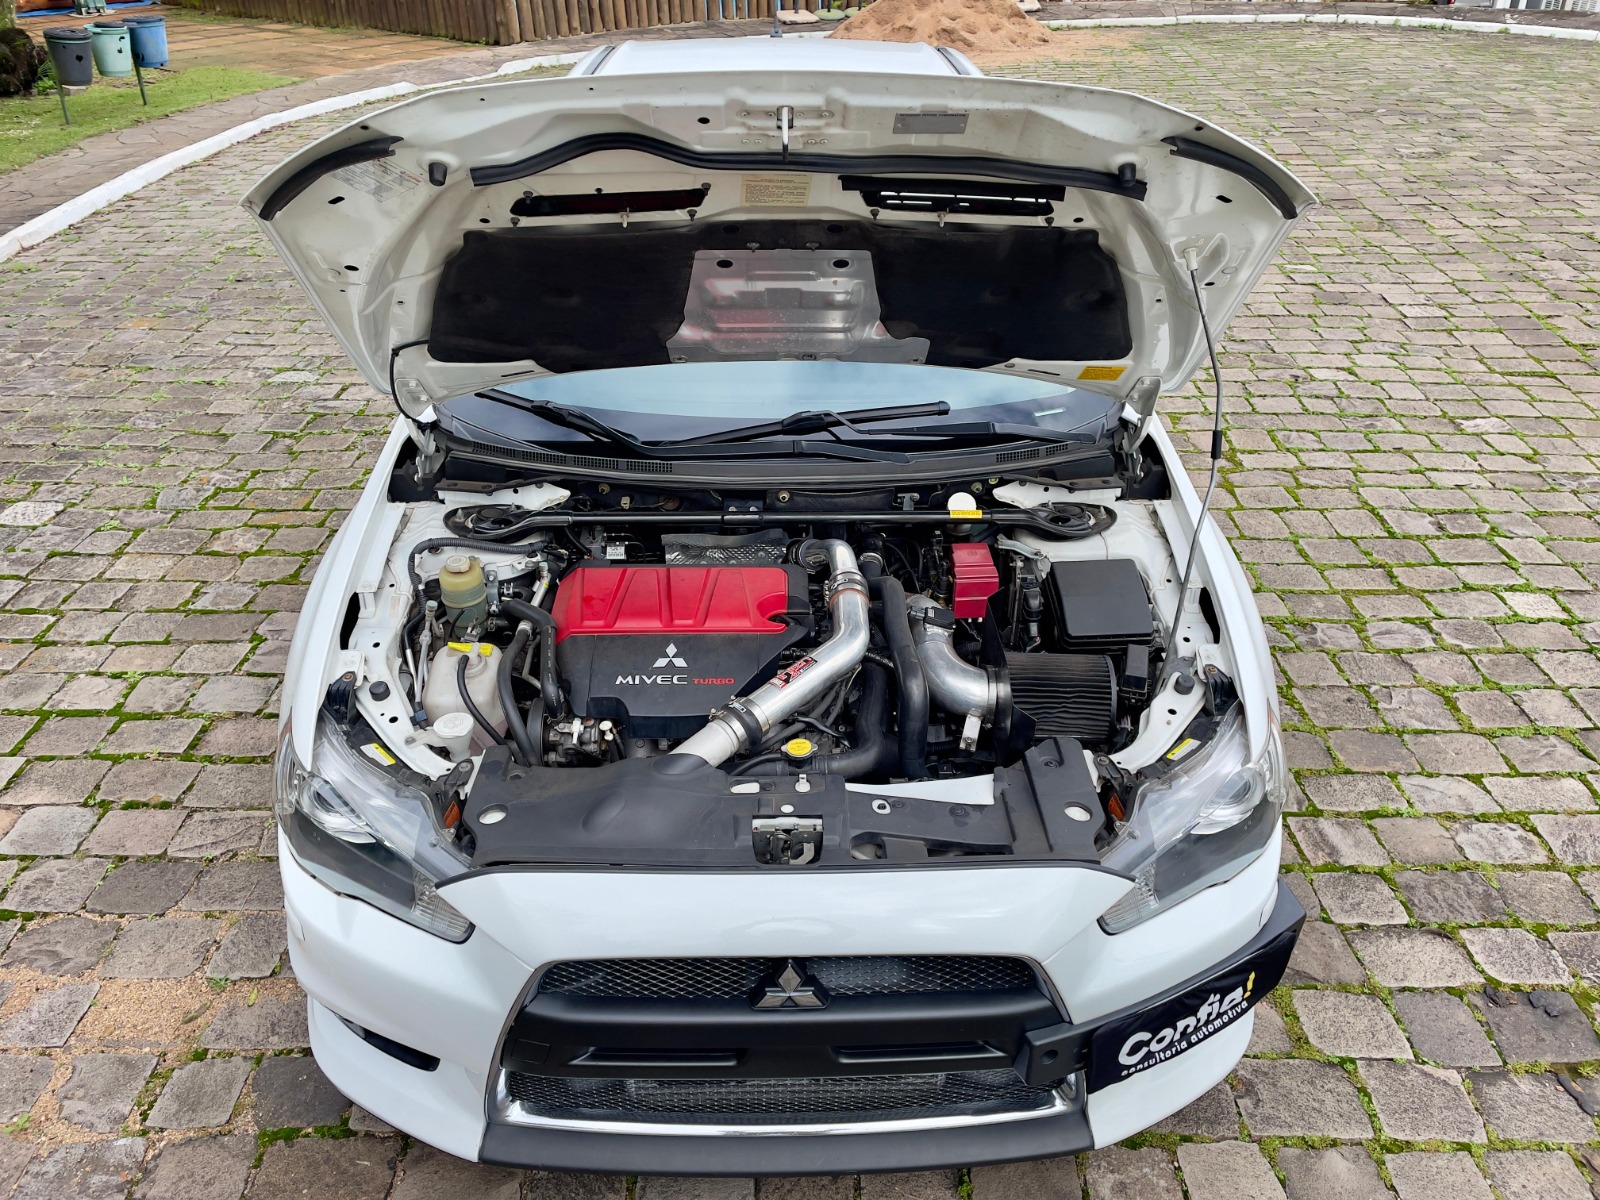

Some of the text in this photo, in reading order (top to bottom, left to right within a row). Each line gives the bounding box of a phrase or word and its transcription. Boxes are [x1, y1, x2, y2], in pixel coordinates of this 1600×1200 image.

[615, 674, 735, 685] MIVEC TURBO
[1121, 1000, 1249, 1077] consultoria automotiva
